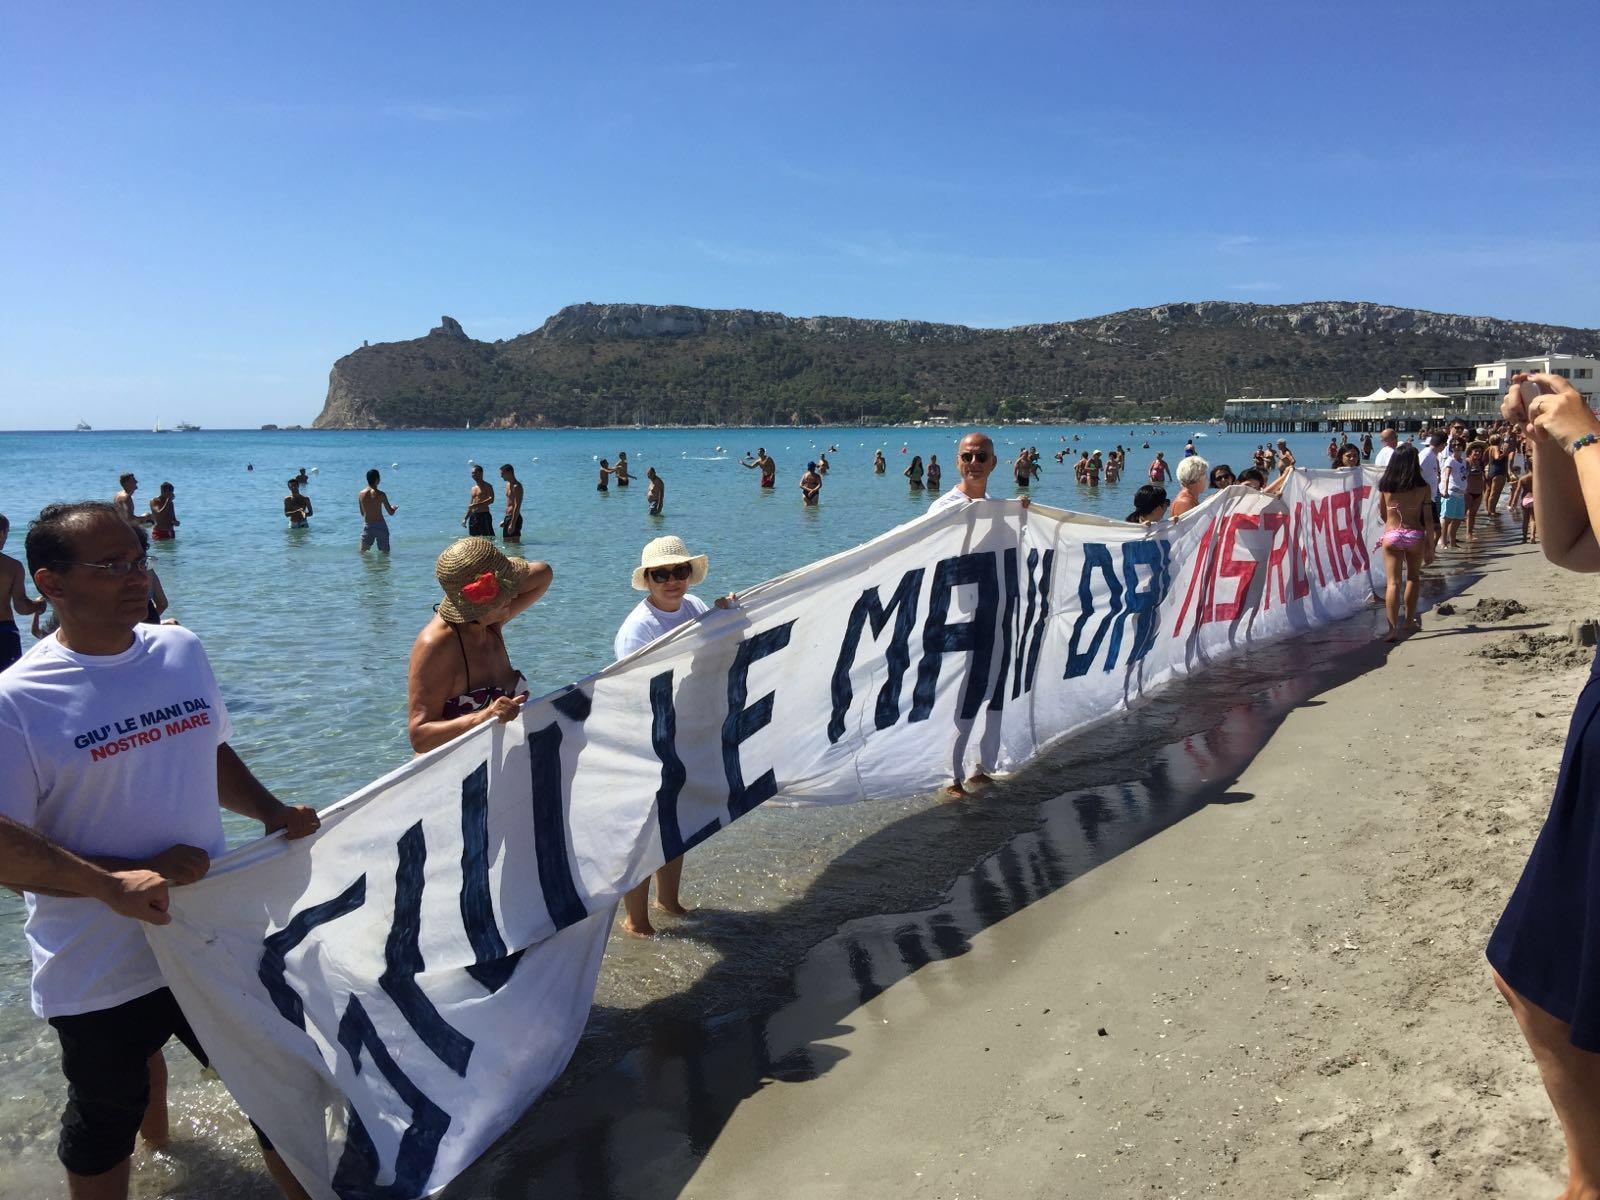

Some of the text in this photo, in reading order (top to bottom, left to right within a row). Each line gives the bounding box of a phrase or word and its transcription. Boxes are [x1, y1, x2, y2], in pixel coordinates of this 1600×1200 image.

[74, 697, 210, 749] GIU' LE MANI DAL
[650, 617, 799, 864] LE
[828, 546, 1054, 744] MANI
[90, 712, 211, 762] NOSTRO MARE
